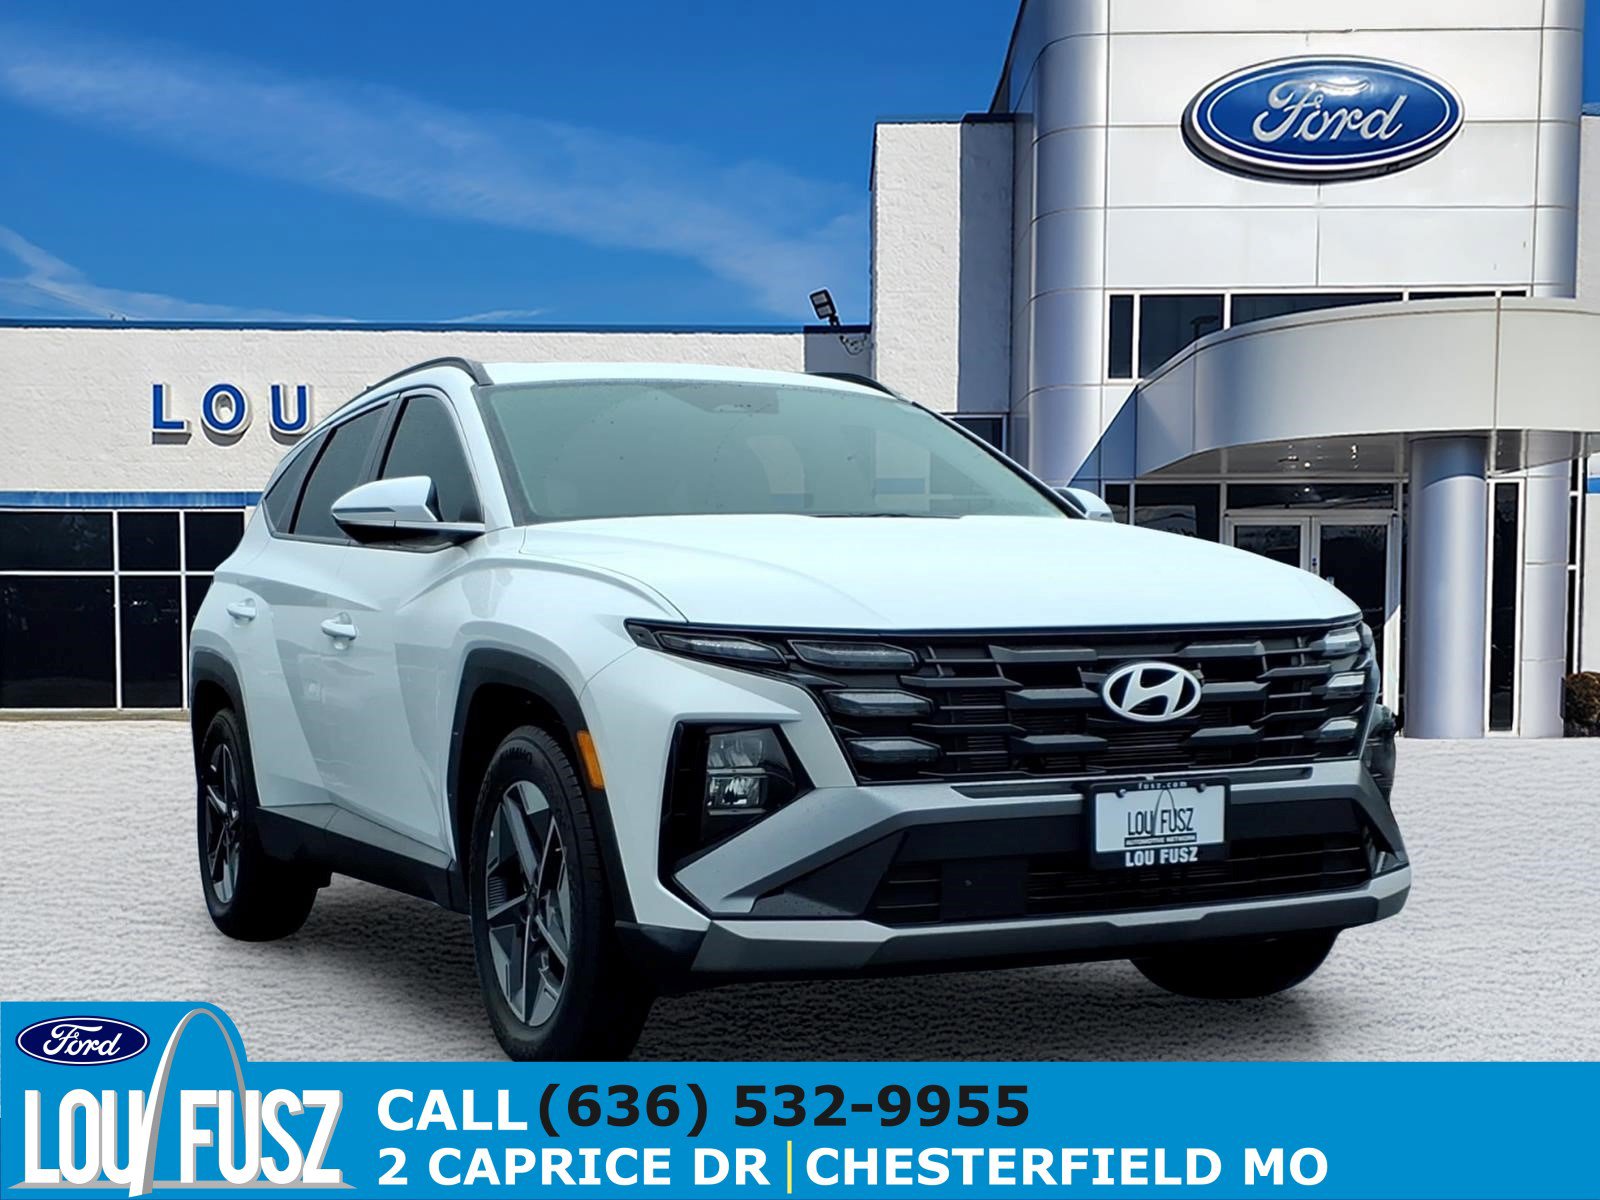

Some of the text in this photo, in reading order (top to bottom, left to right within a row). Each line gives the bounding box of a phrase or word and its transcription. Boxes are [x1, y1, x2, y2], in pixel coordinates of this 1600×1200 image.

[1252, 79, 1407, 142] Ford
[152, 383, 310, 435] LOU
[1138, 782, 1187, 790] fusz.com
[1128, 808, 1194, 836] LOU FUSZ
[1125, 847, 1198, 867] LOU FUSZ
